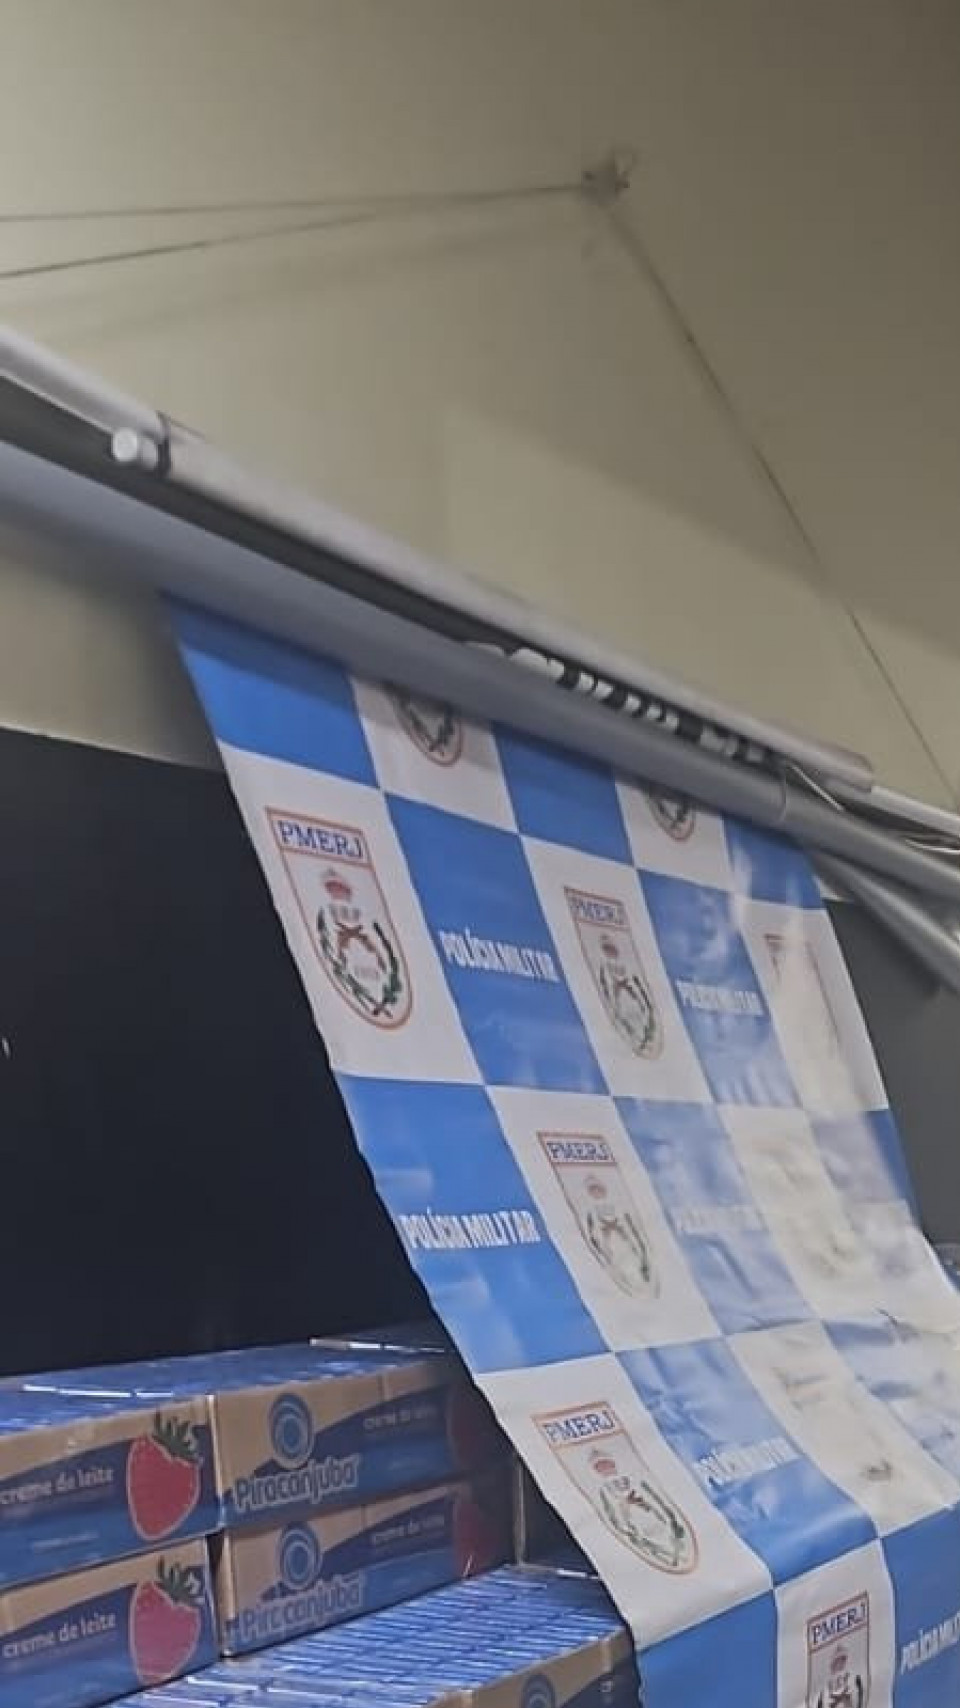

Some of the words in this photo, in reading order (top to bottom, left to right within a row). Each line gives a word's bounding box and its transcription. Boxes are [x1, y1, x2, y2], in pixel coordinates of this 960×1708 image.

[277, 819, 364, 859] PMERJ
[545, 1142, 613, 1162] PMERJ
[398, 1205, 472, 1249] POLÍCIA
[460, 1209, 541, 1249] MILITAR
[543, 1410, 616, 1443] PMERJ
[55, 1470, 78, 1492] de
[77, 1464, 115, 1489] leite
[231, 1452, 362, 1513] Piracanjuba
[239, 1568, 366, 1644] Piracanjuba
[812, 1603, 866, 1645] PMERJ
[2, 1630, 56, 1659] creme
[58, 1623, 80, 1643] de
[80, 1611, 117, 1638] leite
[900, 1626, 940, 1677] POLÍCIA
